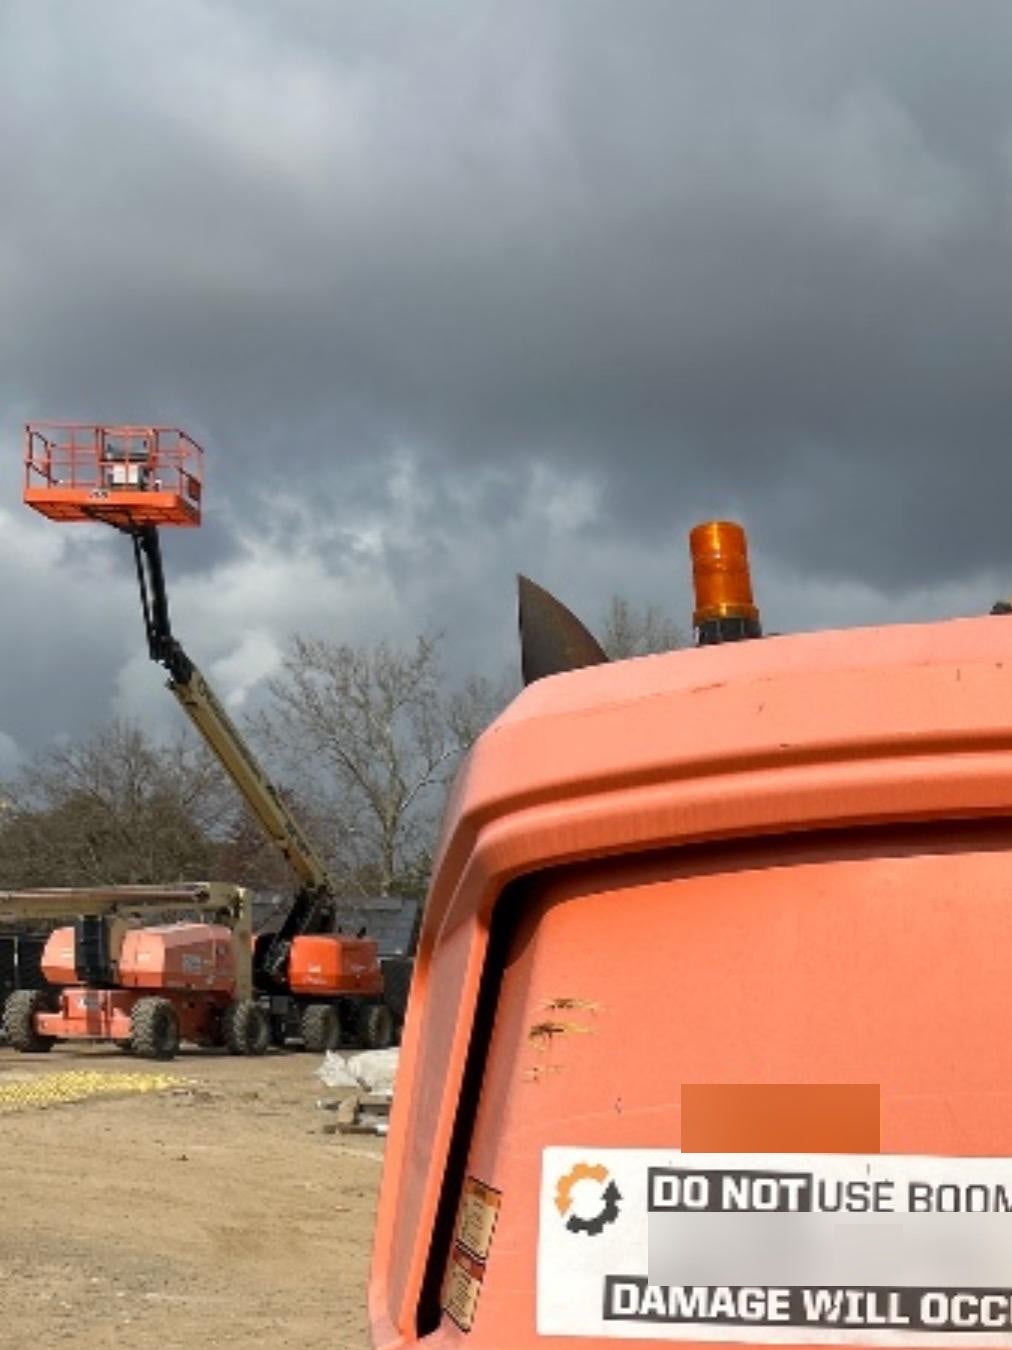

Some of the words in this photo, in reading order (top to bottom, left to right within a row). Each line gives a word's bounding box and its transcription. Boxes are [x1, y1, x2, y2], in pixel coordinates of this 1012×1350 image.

[652, 1174, 709, 1209] DO
[721, 1176, 806, 1211] NOT
[818, 1179, 896, 1212] USE
[612, 1283, 791, 1321] DAMAGE
[803, 1290, 910, 1325] WILL
